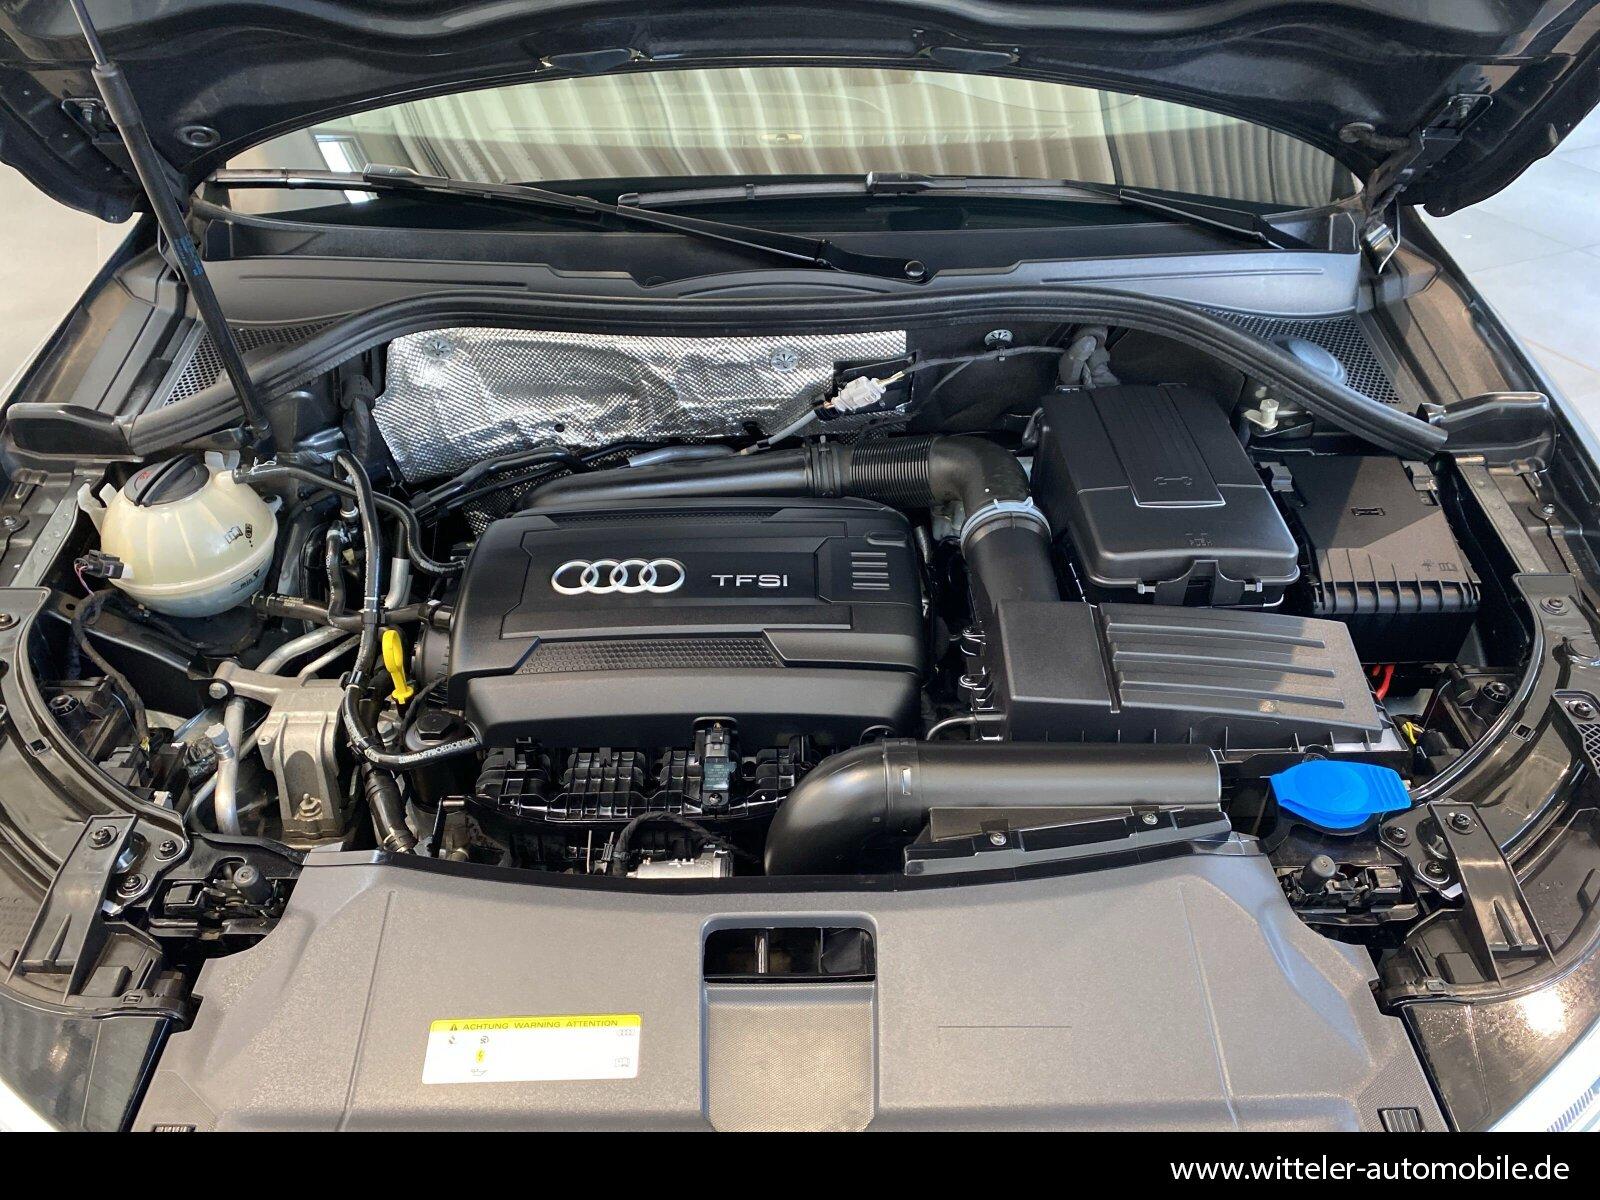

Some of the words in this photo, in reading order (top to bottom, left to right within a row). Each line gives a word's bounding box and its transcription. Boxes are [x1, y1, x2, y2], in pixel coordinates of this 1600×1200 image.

[711, 574, 788, 587] TFSI
[462, 1021, 509, 1031] ACHTUNG
[514, 1020, 561, 1030] WARNING
[566, 1018, 619, 1028] ATTENTION
